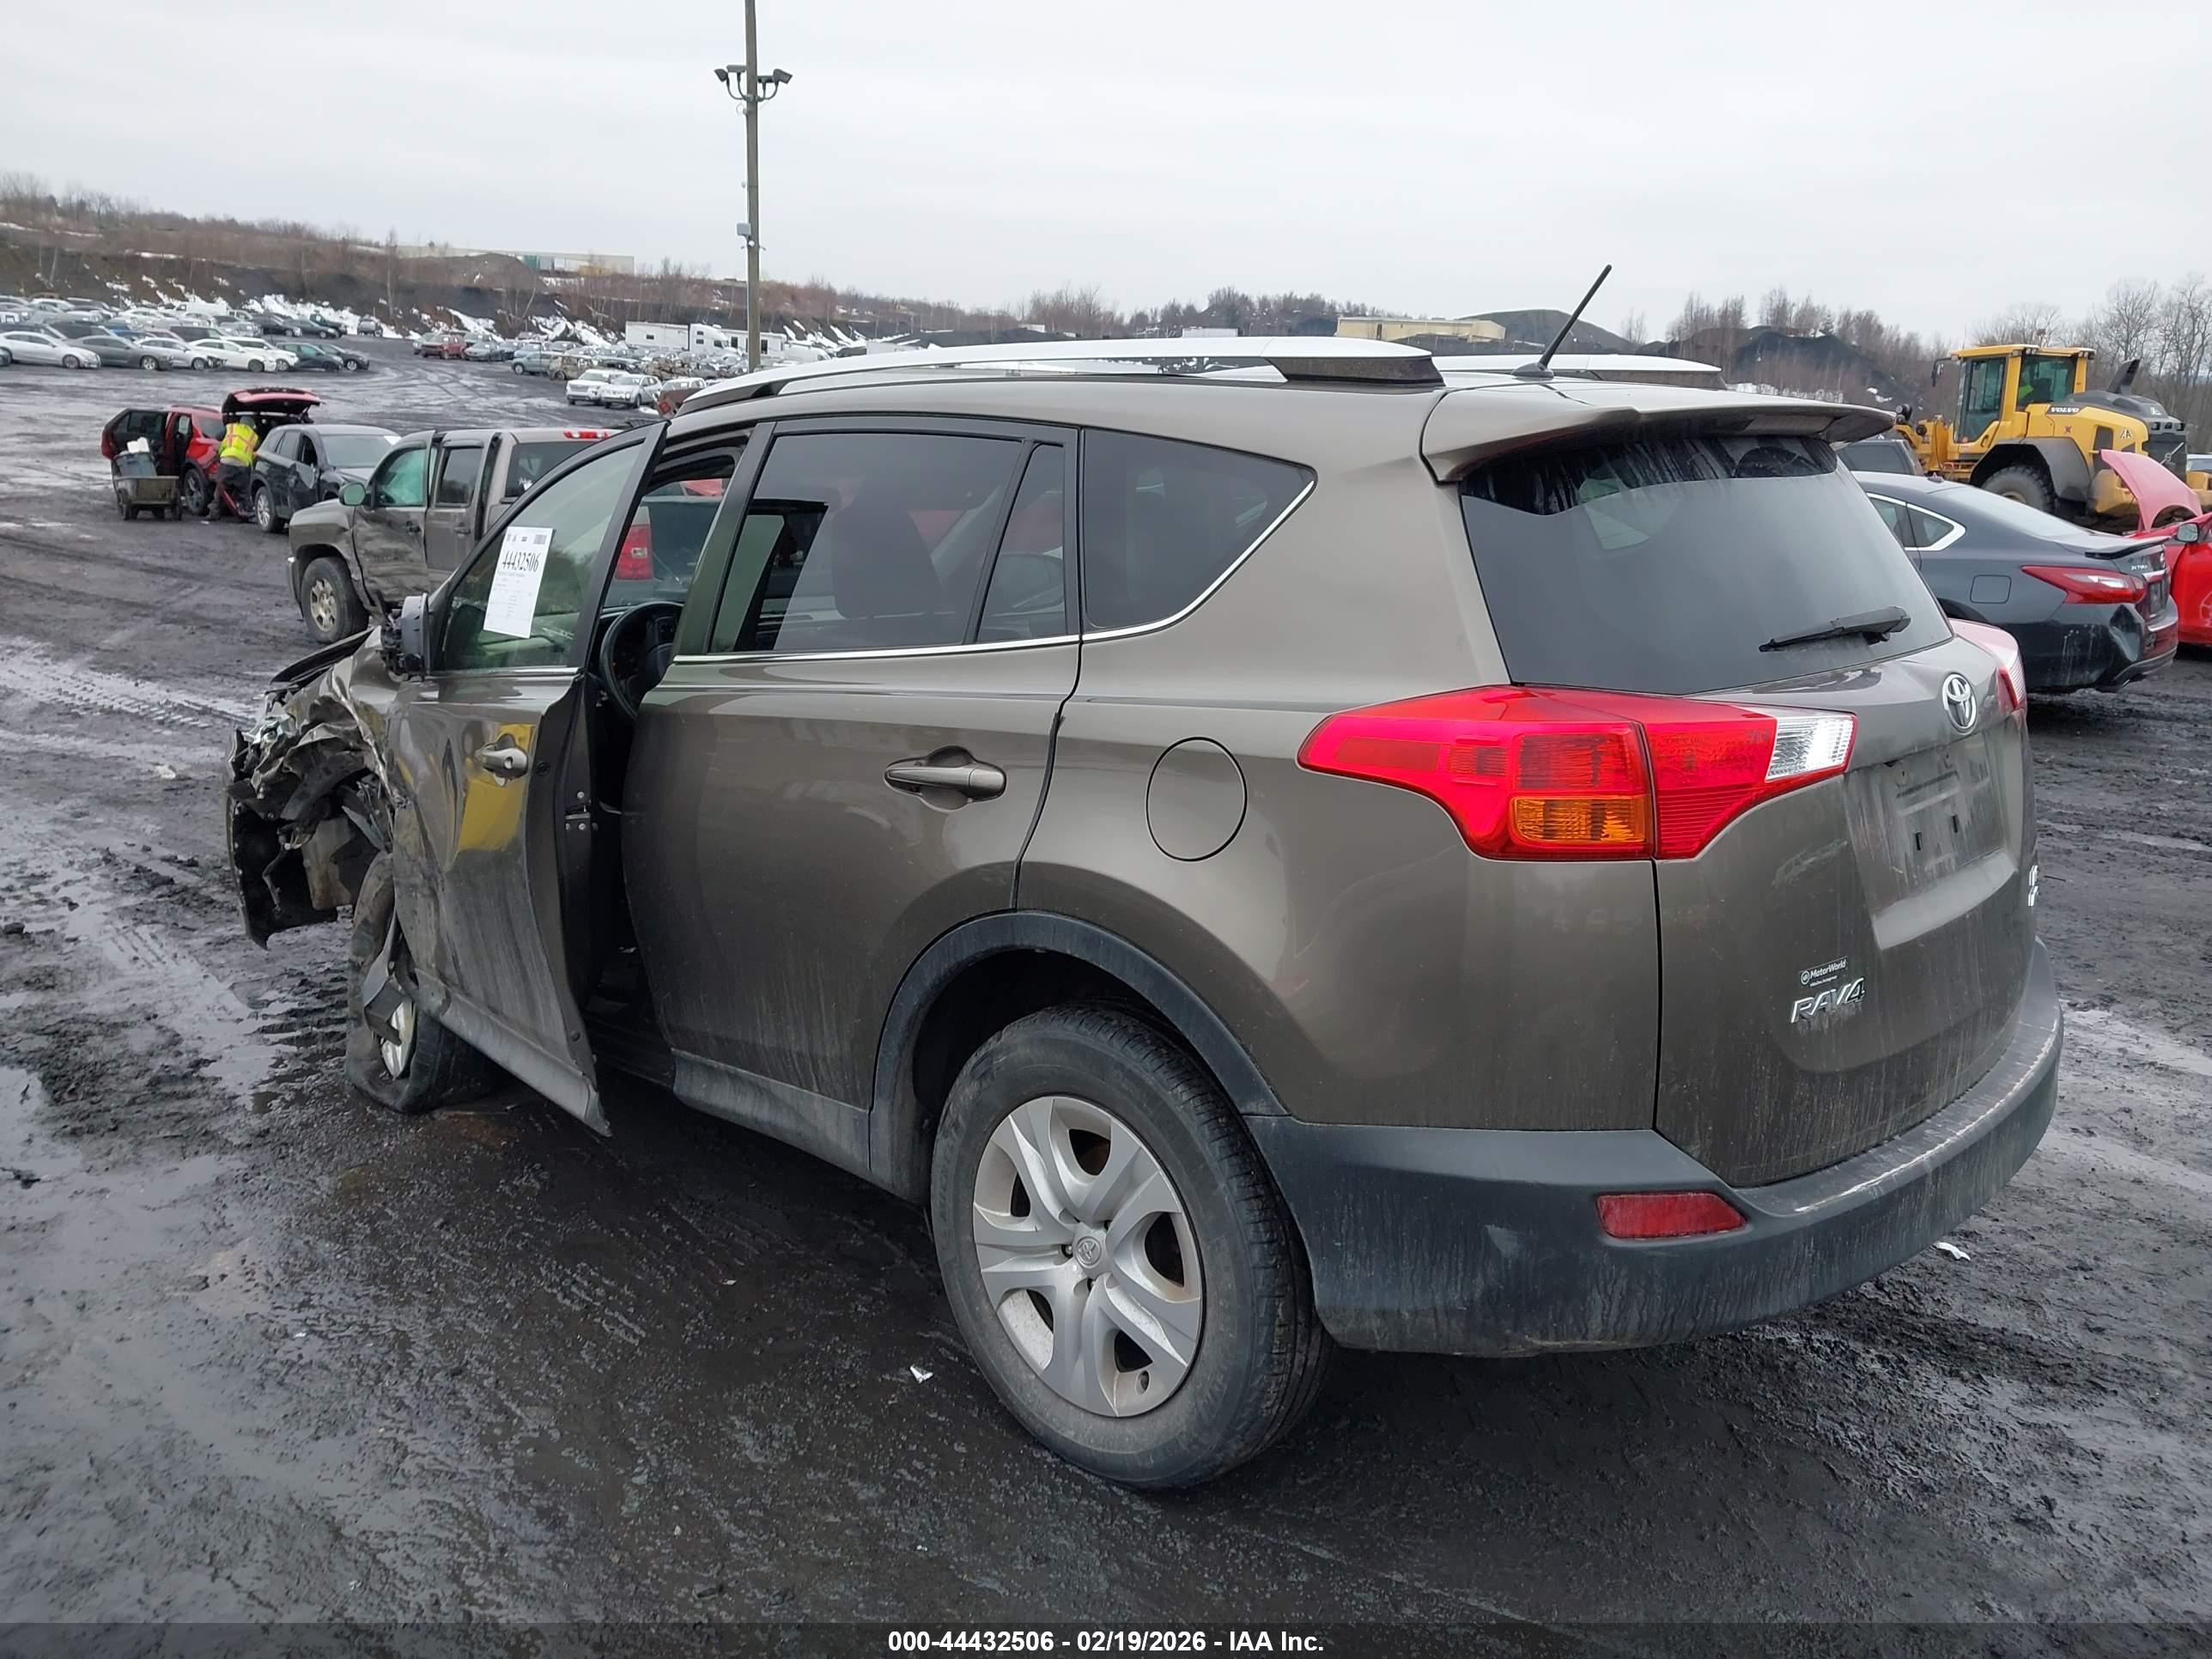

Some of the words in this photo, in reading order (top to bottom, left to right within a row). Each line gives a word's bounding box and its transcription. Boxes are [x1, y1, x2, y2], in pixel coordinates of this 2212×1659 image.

[501, 550, 541, 573] 44432506
[1809, 958, 1847, 980] MotorWorld
[1790, 977, 1865, 1024] RAV4
